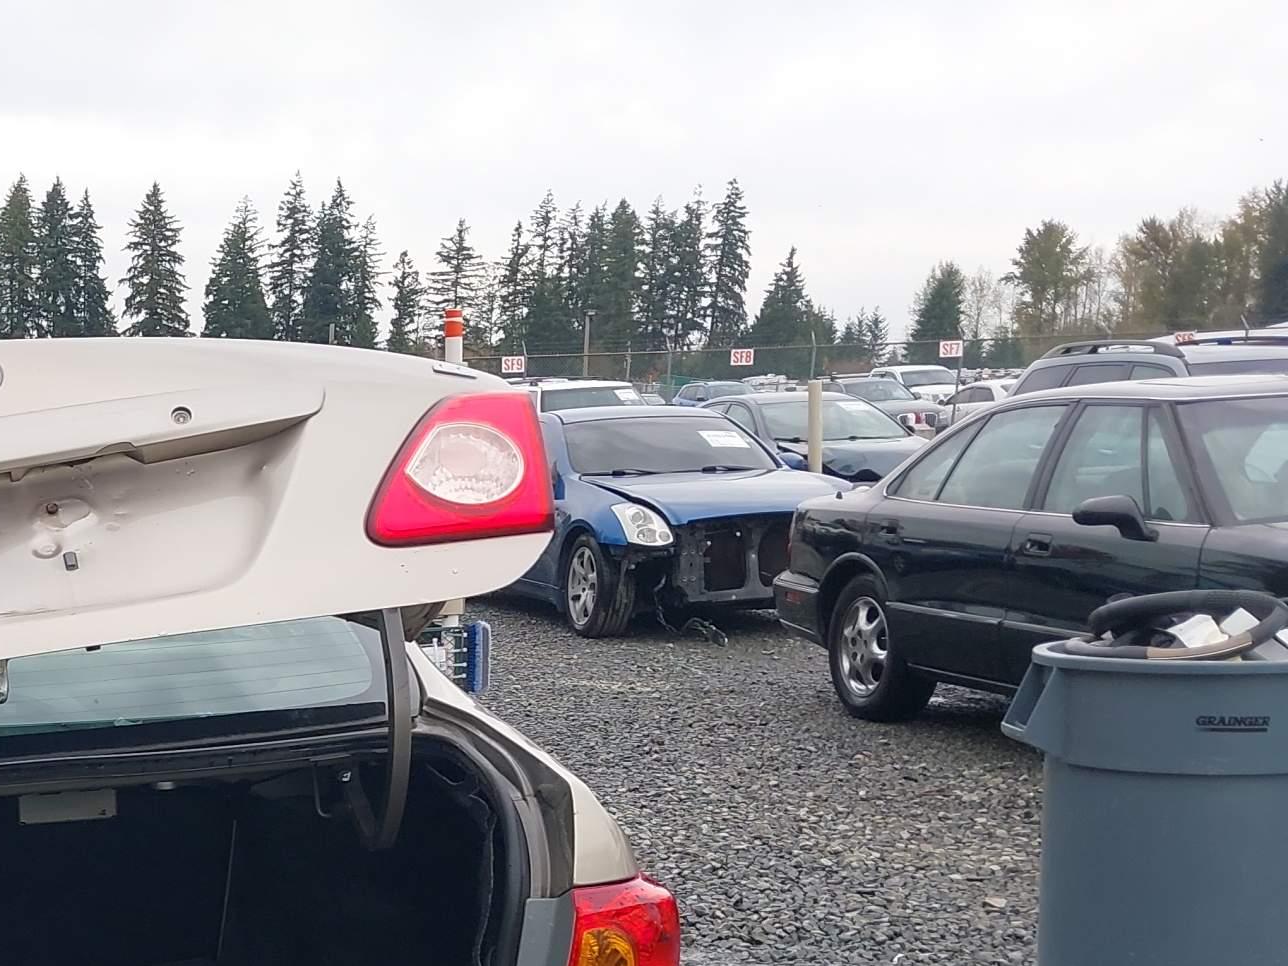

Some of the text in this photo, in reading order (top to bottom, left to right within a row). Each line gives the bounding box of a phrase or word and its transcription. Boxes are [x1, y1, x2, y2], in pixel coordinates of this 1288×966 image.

[942, 342, 961, 356] SF7
[733, 350, 752, 363] SF8
[503, 358, 523, 371] SF9
[1195, 715, 1271, 727] GRAINGER
